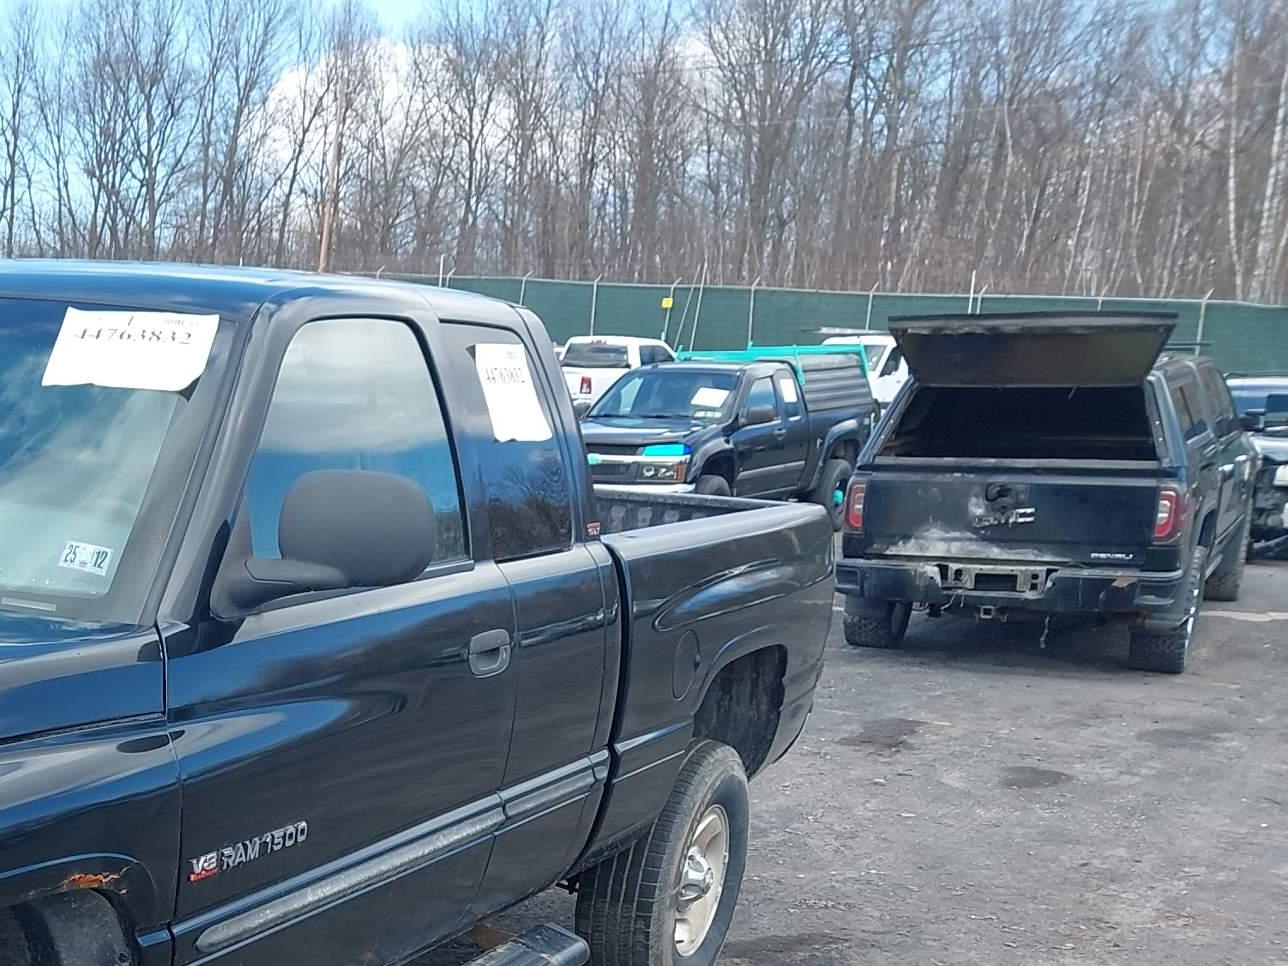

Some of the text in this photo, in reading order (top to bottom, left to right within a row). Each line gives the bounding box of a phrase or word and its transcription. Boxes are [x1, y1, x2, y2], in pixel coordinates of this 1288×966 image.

[74, 327, 192, 345] 44763832
[64, 544, 109, 569] 25 12
[188, 852, 217, 875] V8
[220, 837, 261, 871] RAM
[261, 820, 309, 854] 1500
